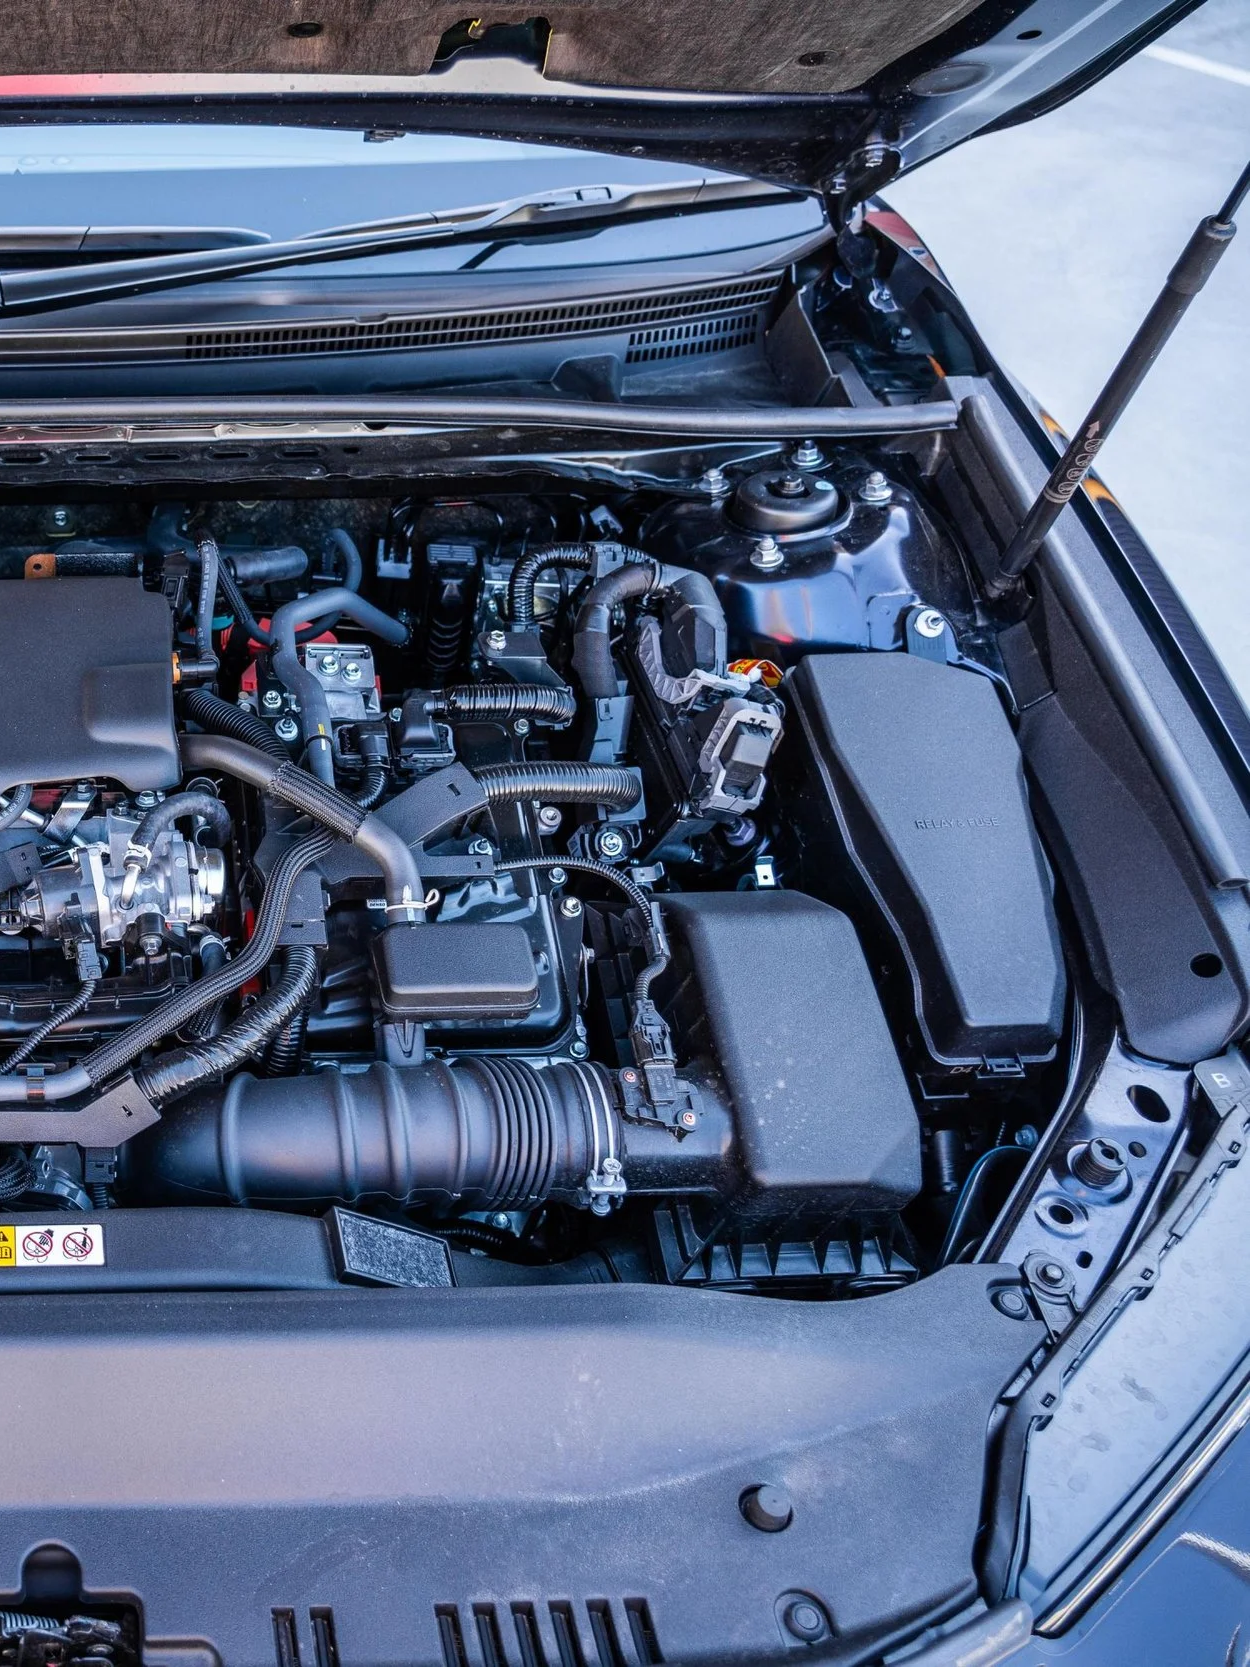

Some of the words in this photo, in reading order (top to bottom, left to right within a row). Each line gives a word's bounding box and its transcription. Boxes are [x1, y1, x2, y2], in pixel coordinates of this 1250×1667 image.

[915, 819, 954, 830] RELAY
[957, 820, 965, 829] &
[967, 817, 1000, 828] FUSE
[1210, 1072, 1231, 1089] B
